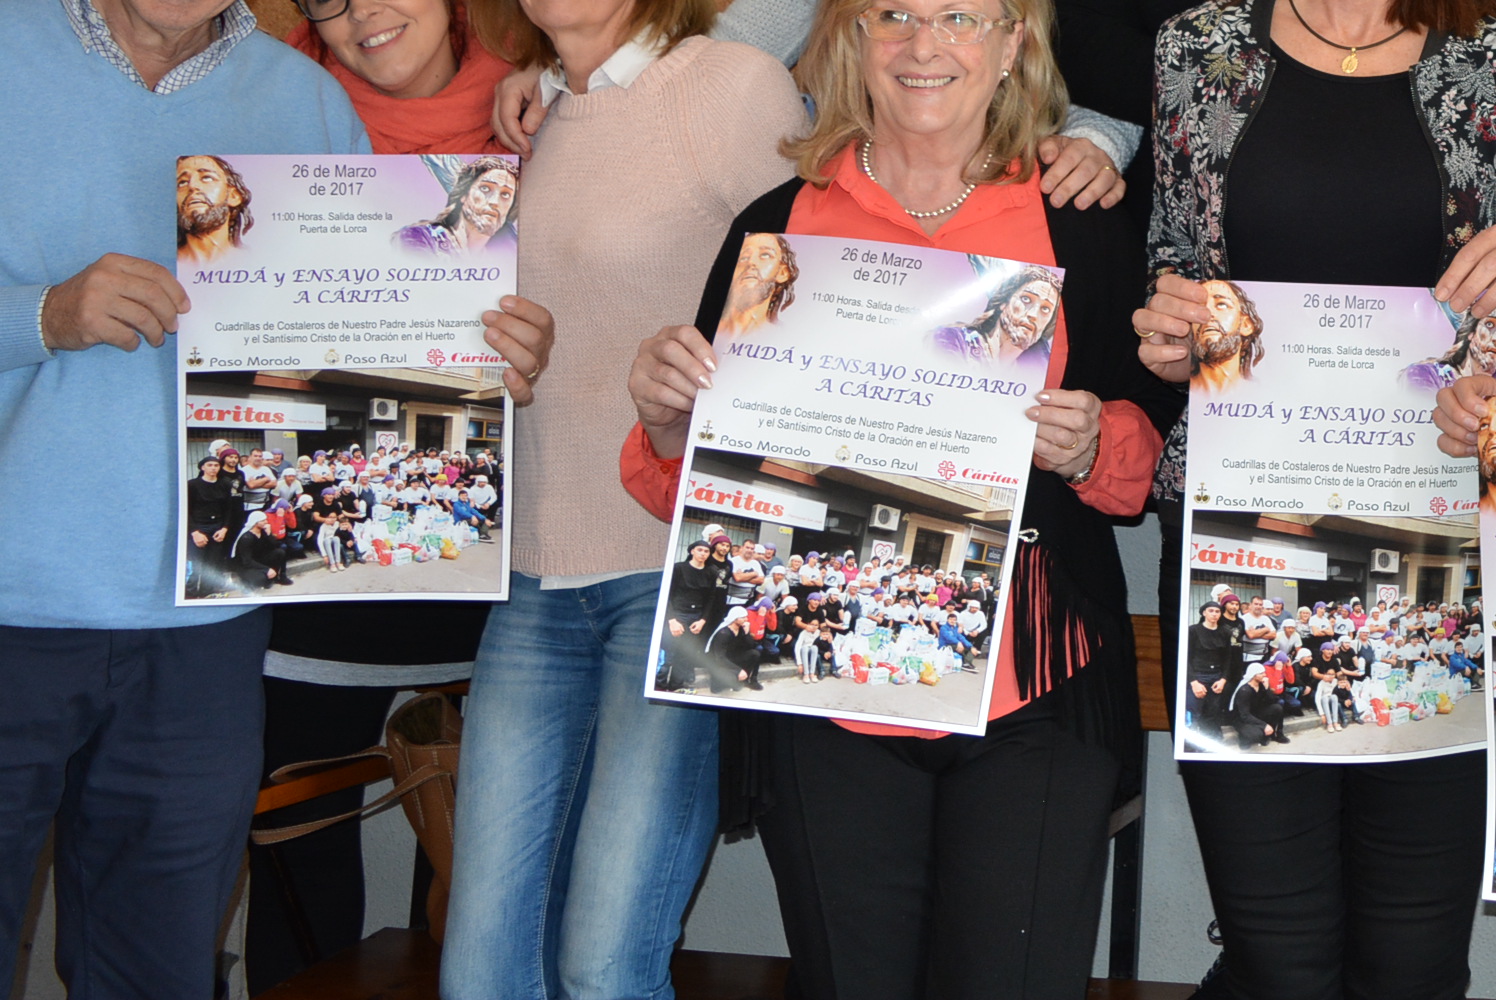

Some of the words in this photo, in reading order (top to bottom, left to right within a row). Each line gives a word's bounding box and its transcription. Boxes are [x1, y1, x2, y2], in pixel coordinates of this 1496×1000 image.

[292, 164, 309, 178] 26
[313, 164, 330, 178] de
[334, 164, 376, 178] Marzo
[308, 182, 326, 196] de
[330, 181, 363, 196] 2017
[271, 212, 295, 221] 11:00
[297, 212, 325, 221] Horas.
[327, 211, 354, 221] Salida
[356, 212, 383, 221] desde
[384, 211, 392, 220] la
[299, 224, 328, 233] Puerta
[329, 224, 341, 233] de
[343, 224, 367, 233] Lorca
[840, 247, 858, 261] 26
[861, 249, 877, 264] de
[881, 251, 922, 270] Marzo
[192, 266, 267, 284] MUDÁ
[273, 272, 285, 287] y
[292, 268, 379, 285] ENSAYO
[385, 267, 500, 281] SOLIDARIO
[853, 266, 870, 281] de
[872, 268, 907, 285] 2017
[293, 290, 310, 304] A
[317, 287, 410, 303] CÁRITAS
[1303, 293, 1320, 308] 26
[1323, 294, 1340, 309] de
[1344, 295, 1385, 310] Marzo
[1318, 313, 1335, 328] de
[1339, 313, 1372, 328] 2017
[209, 357, 242, 367] Paso
[246, 356, 300, 366] Morado
[344, 354, 376, 364] Paso
[380, 353, 406, 363] Azul
[724, 342, 794, 363] MUDÁ
[799, 354, 812, 371] y
[819, 355, 906, 380] ENSAYO
[911, 368, 1027, 396] SOLIDARIO
[815, 378, 832, 393] A
[839, 381, 933, 406] CÁRITAS
[1203, 401, 1274, 418] MUDÁ
[1281, 408, 1292, 424] y
[1299, 405, 1385, 425] ENSAYO
[1299, 428, 1316, 443] A
[1323, 427, 1415, 446] CÁRITAS
[719, 434, 752, 449] Paso
[756, 440, 810, 457] Morado
[854, 453, 887, 467] Paso
[890, 458, 918, 471] Azul
[961, 468, 1018, 484] Cáritas
[1215, 495, 1247, 506] Paso
[1251, 497, 1304, 509] Morado
[1347, 499, 1379, 511] Paso
[1383, 500, 1410, 512] Azul
